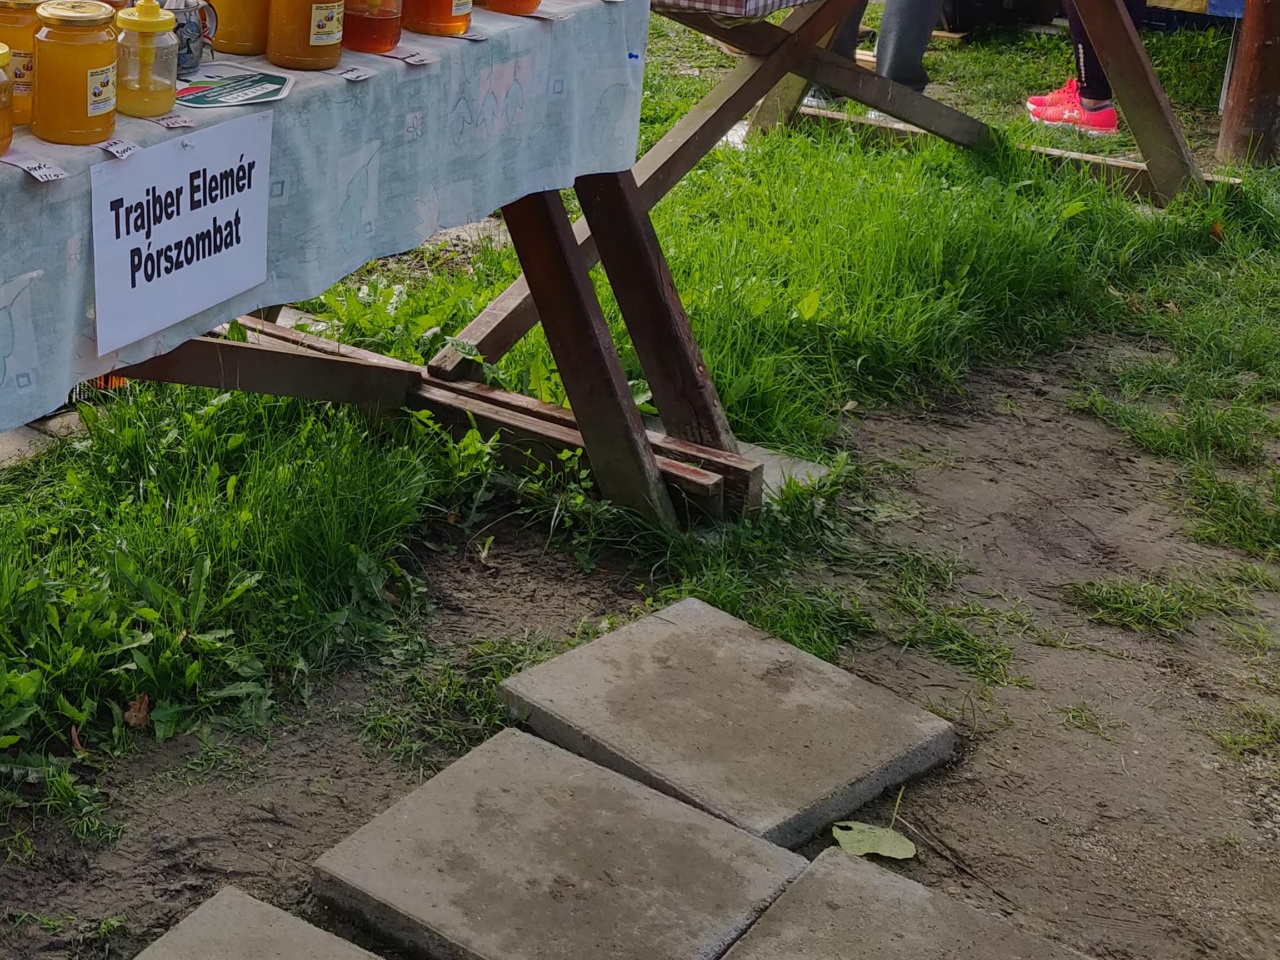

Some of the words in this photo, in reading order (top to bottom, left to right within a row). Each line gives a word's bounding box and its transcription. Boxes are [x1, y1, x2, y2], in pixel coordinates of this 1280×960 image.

[110, 186, 184, 240] Trajber
[189, 153, 256, 211] Elemér
[130, 208, 241, 289] Pórszombat
